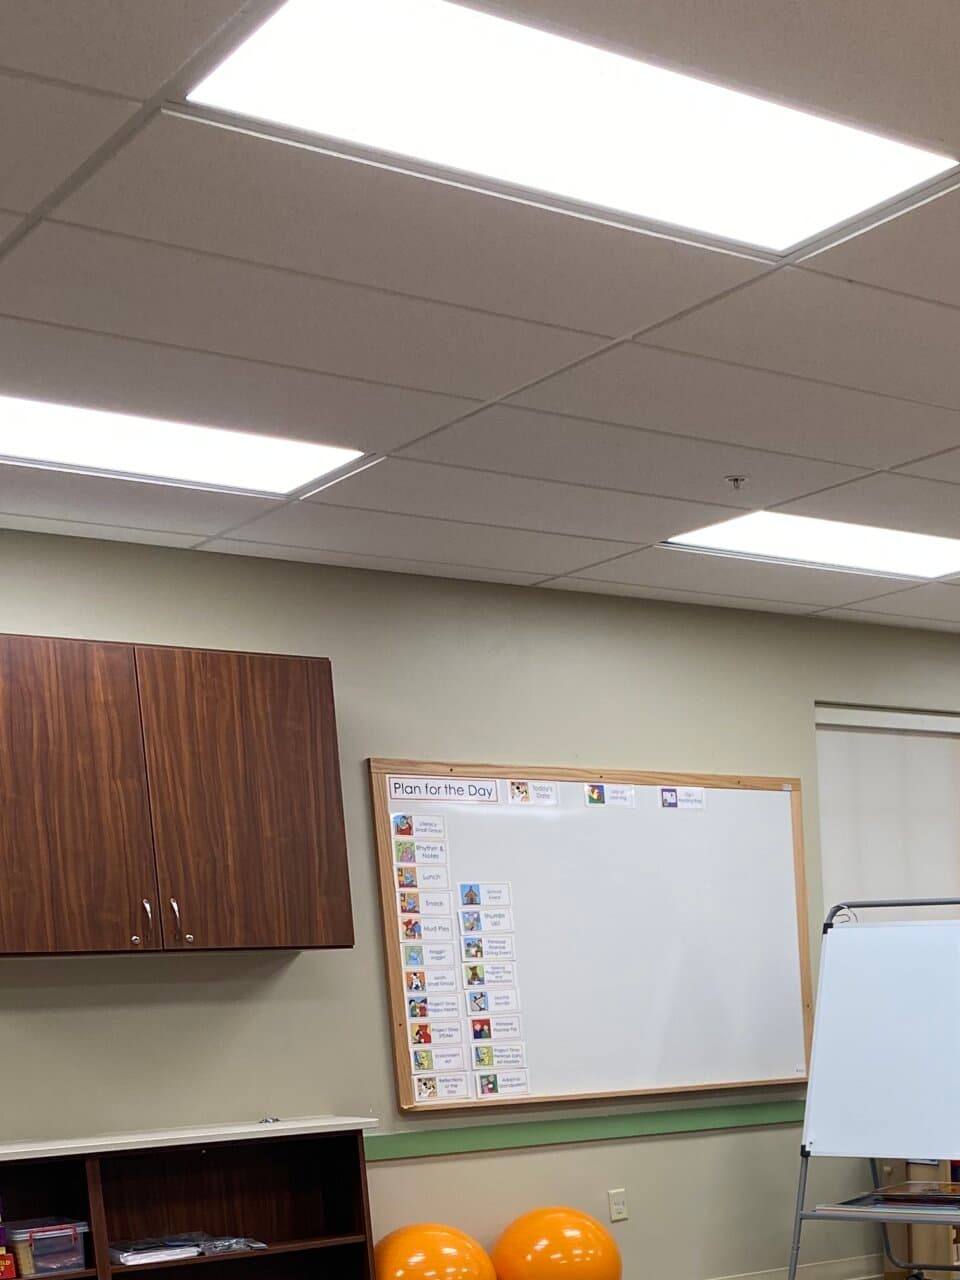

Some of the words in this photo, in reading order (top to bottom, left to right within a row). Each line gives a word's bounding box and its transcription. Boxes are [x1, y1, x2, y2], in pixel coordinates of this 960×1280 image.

[393, 782, 422, 795] Plan
[425, 783, 441, 796] for
[444, 784, 465, 796] the
[468, 785, 493, 799] Day
